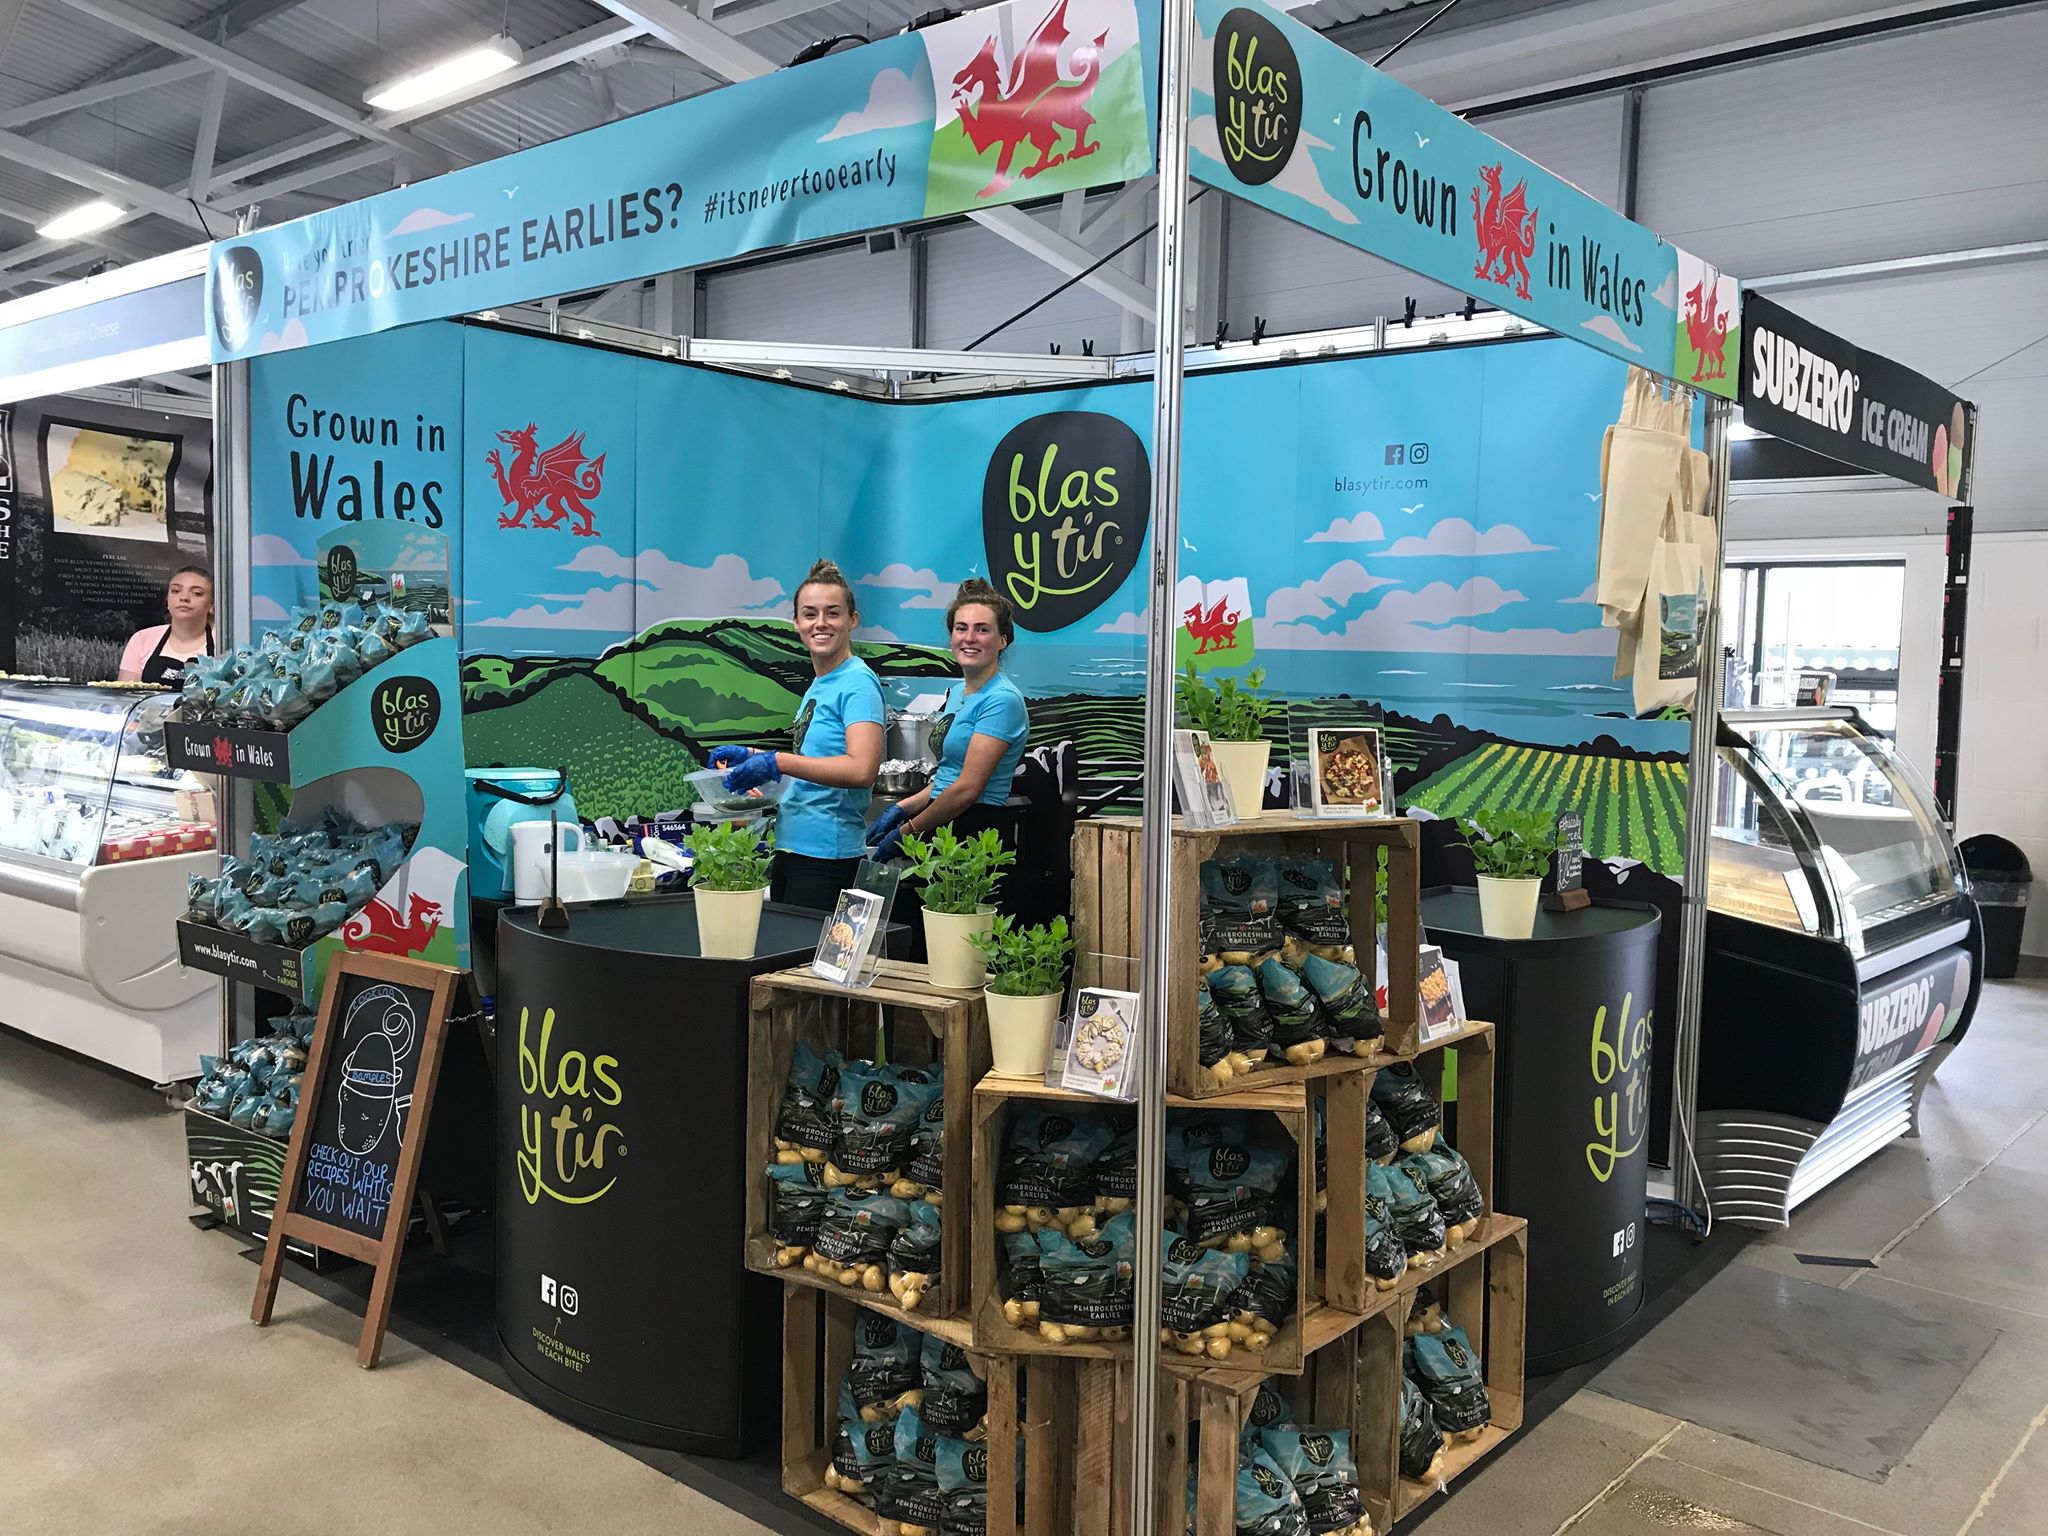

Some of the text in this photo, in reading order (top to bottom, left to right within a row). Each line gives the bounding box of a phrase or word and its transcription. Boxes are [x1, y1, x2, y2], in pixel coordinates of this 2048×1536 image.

[1227, 31, 1288, 104] blas
[704, 148, 896, 224] #itsnevertooearly
[522, 182, 683, 262] EARLIES?
[1352, 110, 1645, 327] Grown in Wales
[286, 393, 445, 452] Grown in
[1861, 397, 1886, 447] ICE
[1887, 408, 1929, 464] CREAM
[290, 450, 444, 529] Wales
[1009, 443, 1120, 523] blas
[1334, 475, 1428, 497] blasytir.com
[330, 553, 352, 575] blas
[382, 686, 429, 715] blas
[184, 736, 274, 767] Grown in Wales
[193, 943, 258, 970] www.blasytir.com
[519, 1006, 622, 1106] blas
[1591, 991, 1653, 1085] blas
[868, 1084, 893, 1099] blas
[307, 1159, 350, 1187] RECIPES
[310, 1143, 389, 1182] CHECK OUT OUR
[1215, 1147, 1244, 1161] blas
[1097, 1173, 1137, 1184] PEMBROKE
[1111, 1183, 1137, 1191] EARLIE
[305, 1179, 385, 1228] YOU WAIT
[1090, 1311, 1121, 1320] EARLIES
[532, 1326, 591, 1364] DISCOVER WALES
[537, 1342, 545, 1353] IN
[544, 1347, 563, 1364] EACH
